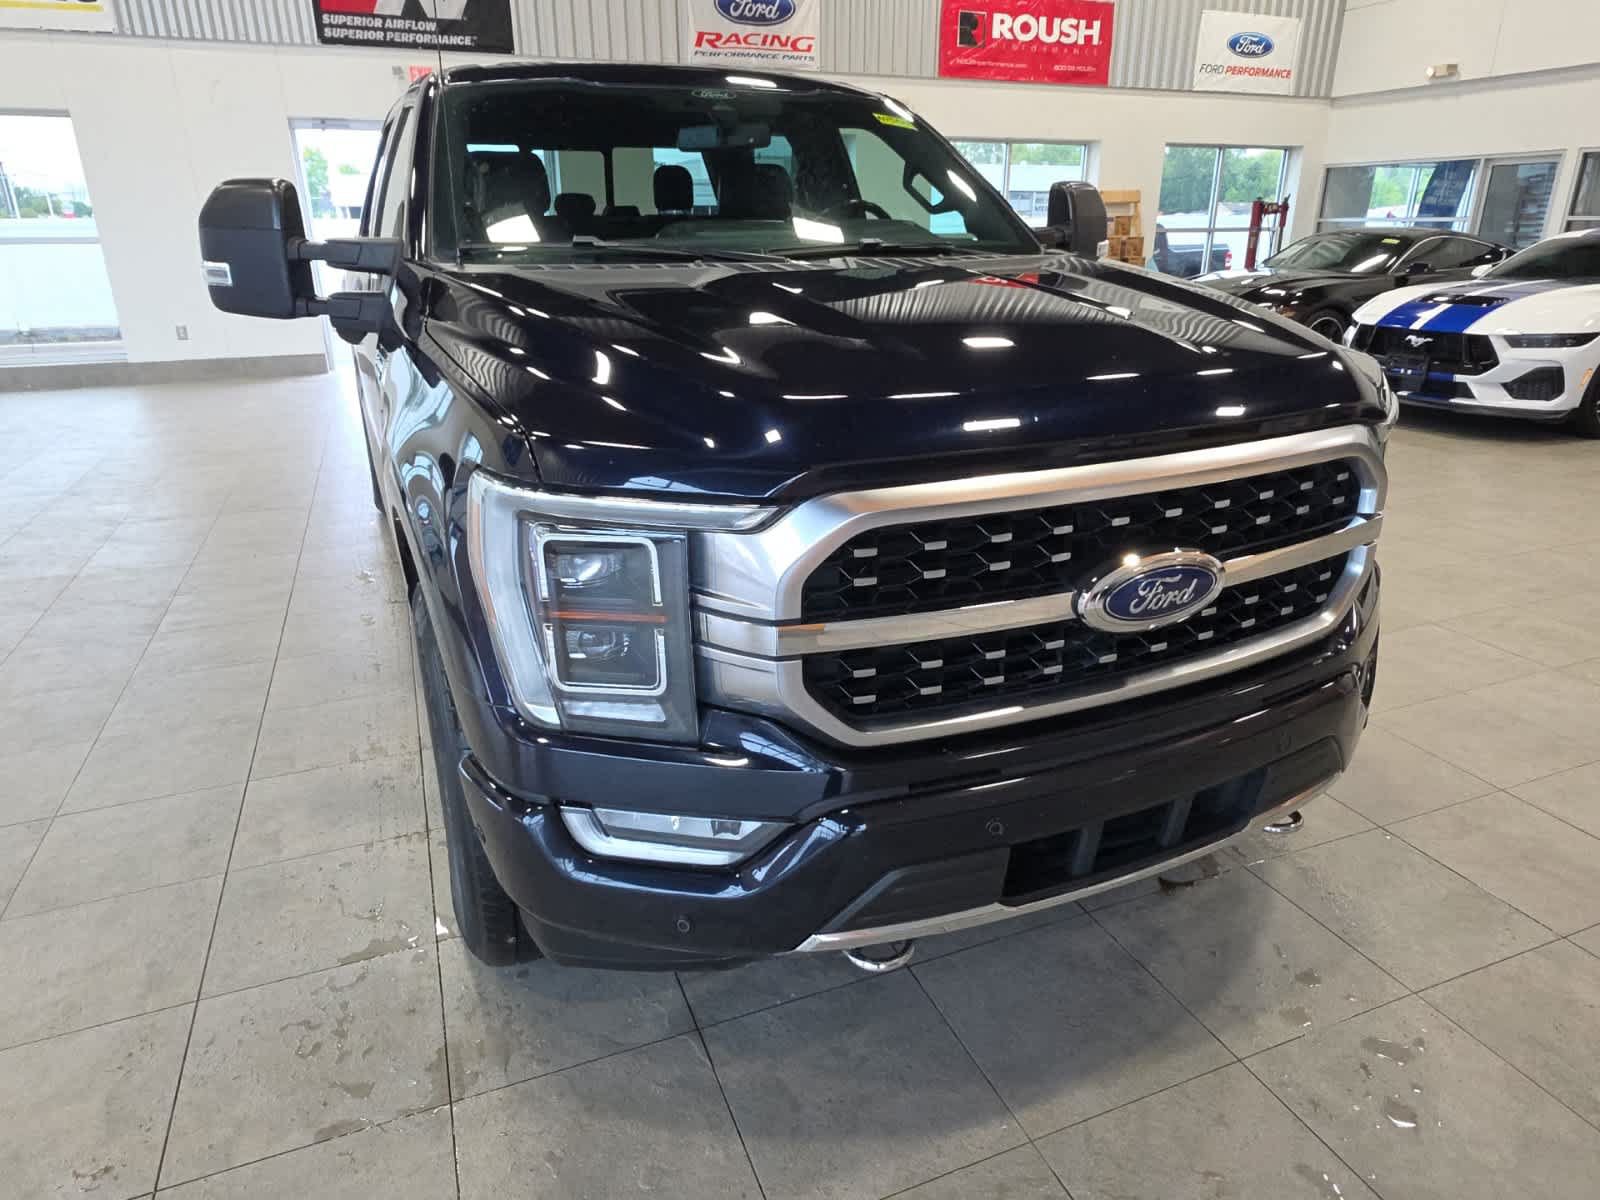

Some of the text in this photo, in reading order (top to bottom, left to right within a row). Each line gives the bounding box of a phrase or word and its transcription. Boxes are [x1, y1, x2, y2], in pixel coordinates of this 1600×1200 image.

[730, 0, 780, 19] Ford
[322, 14, 437, 32] SUPERIOR AIRFLOW
[992, 13, 1101, 46] ROUSH
[324, 27, 384, 40] SUPERIOR
[694, 31, 816, 53] RACING
[1235, 36, 1266, 54] Ford
[694, 50, 815, 62] PERFORMANCE PARTS
[1200, 64, 1292, 79] FORD PERFORMANCE
[1129, 573, 1198, 615] Ford
